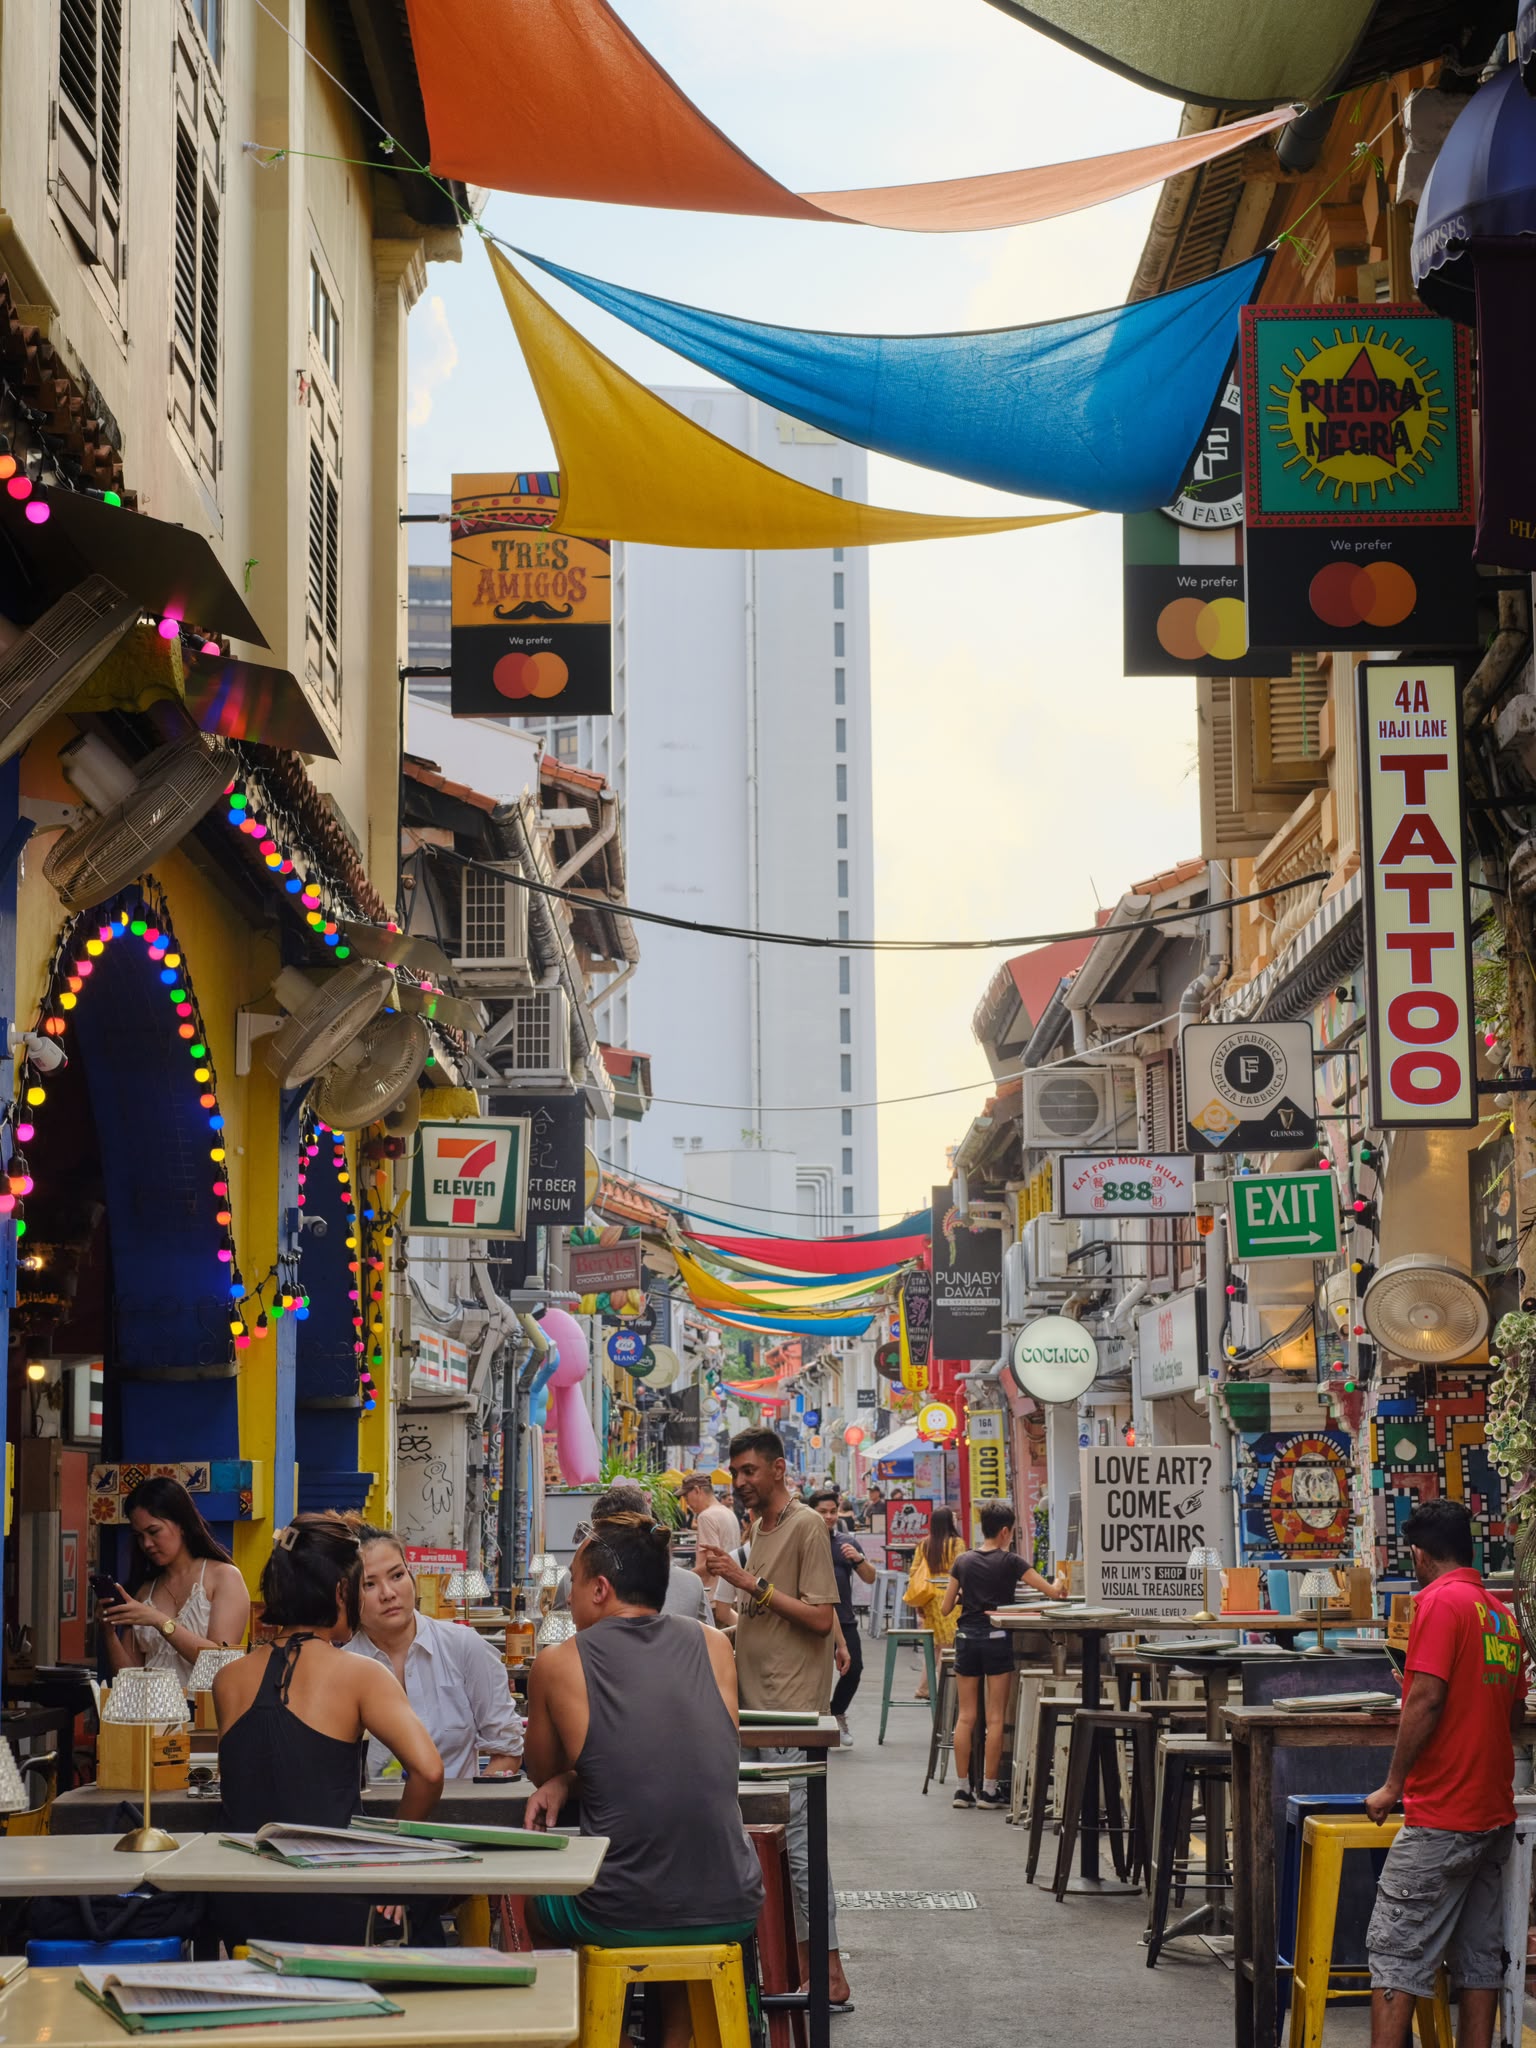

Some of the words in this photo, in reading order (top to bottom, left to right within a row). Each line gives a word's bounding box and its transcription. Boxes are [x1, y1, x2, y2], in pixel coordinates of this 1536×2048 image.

[1300, 378, 1422, 414] PIEDRA
[1305, 421, 1413, 456] NEGRA
[492, 539, 568, 571] TRES
[1330, 539, 1351, 551] We
[1354, 539, 1392, 553] prefer
[472, 566, 587, 606] AMIGOS
[1177, 577, 1198, 588] We
[1201, 576, 1238, 590] prefer
[509, 637, 524, 645] We
[526, 636, 552, 648] prefer
[1394, 680, 1430, 713] 4A
[1379, 720, 1411, 738] HAJI
[1415, 720, 1447, 738] LANE
[1378, 753, 1462, 1106] TATTOO
[1214, 1040, 1237, 1068] PIZZA
[1237, 1034, 1283, 1065] FABBRICA
[1240, 1055, 1259, 1083] F
[1214, 1073, 1238, 1101] PIZZA
[1239, 1073, 1284, 1104] FABBRICA
[1270, 1129, 1304, 1137] GUINNESS
[1072, 1170, 1091, 1191] EAT
[1091, 1158, 1115, 1174] FOR
[1118, 1156, 1153, 1168] MORE
[1155, 1164, 1184, 1189] HUAT
[545, 1179, 576, 1192] BEER
[1103, 1181, 1154, 1201] 888
[527, 1197, 541, 1211] IM
[543, 1198, 571, 1211] SUM
[1245, 1183, 1320, 1226] EXIT
[576, 1251, 633, 1273] Beryl's
[577, 1275, 614, 1284] CHOCOLATE
[616, 1273, 635, 1281] STORY
[935, 1271, 1000, 1287] PUNJABY
[945, 1287, 992, 1297] DAWAT
[1021, 1347, 1089, 1364] COCLICO
[979, 1418, 992, 1427] 16A
[1095, 1456, 1149, 1485] LOVE
[1156, 1457, 1212, 1485] ART?
[1107, 1490, 1171, 1518] COME
[1101, 1524, 1205, 1552] UPSTAIRS
[1101, 1566, 1118, 1579] MR
[1121, 1566, 1151, 1579] LIM'S
[1158, 1568, 1183, 1579] SHOP
[1102, 1583, 1139, 1596] VISUAL
[1142, 1583, 1204, 1596] TREASURES
[1162, 1608, 1180, 1616] LEVEL
